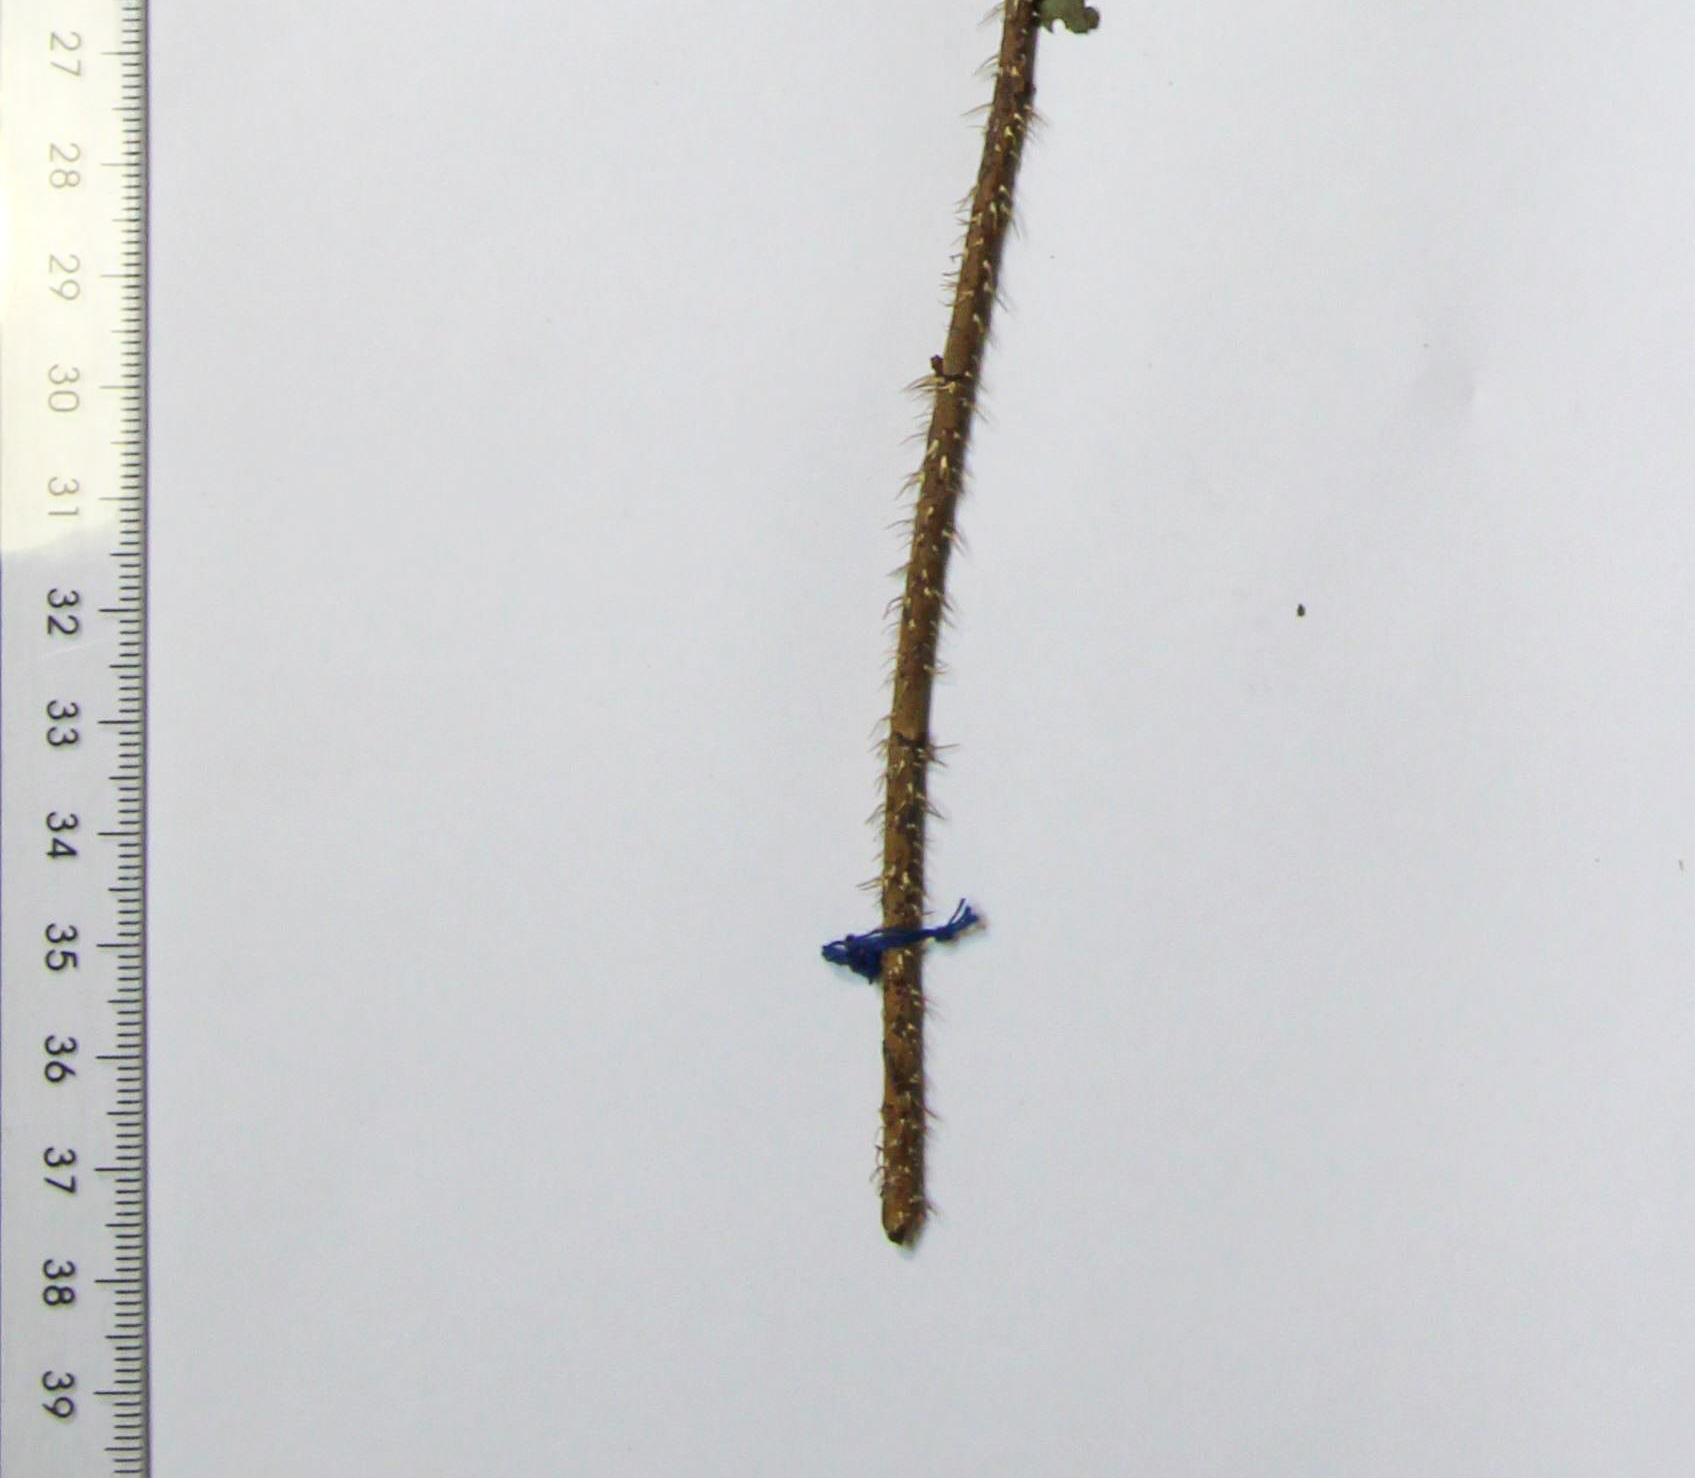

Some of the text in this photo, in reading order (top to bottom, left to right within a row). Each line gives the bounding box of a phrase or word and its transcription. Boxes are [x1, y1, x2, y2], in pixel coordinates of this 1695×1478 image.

[48, 31, 82, 77] 27
[48, 142, 82, 190] 28
[48, 254, 82, 301] 29
[47, 364, 81, 413] 30
[47, 476, 80, 517] 31
[45, 588, 82, 640] 32
[45, 700, 82, 751] 33
[44, 811, 80, 862] 34
[44, 923, 80, 974] 35
[43, 1034, 80, 1088] 36
[42, 1146, 78, 1198] 37
[40, 1258, 78, 1310] 38
[40, 1370, 77, 1424] 39
